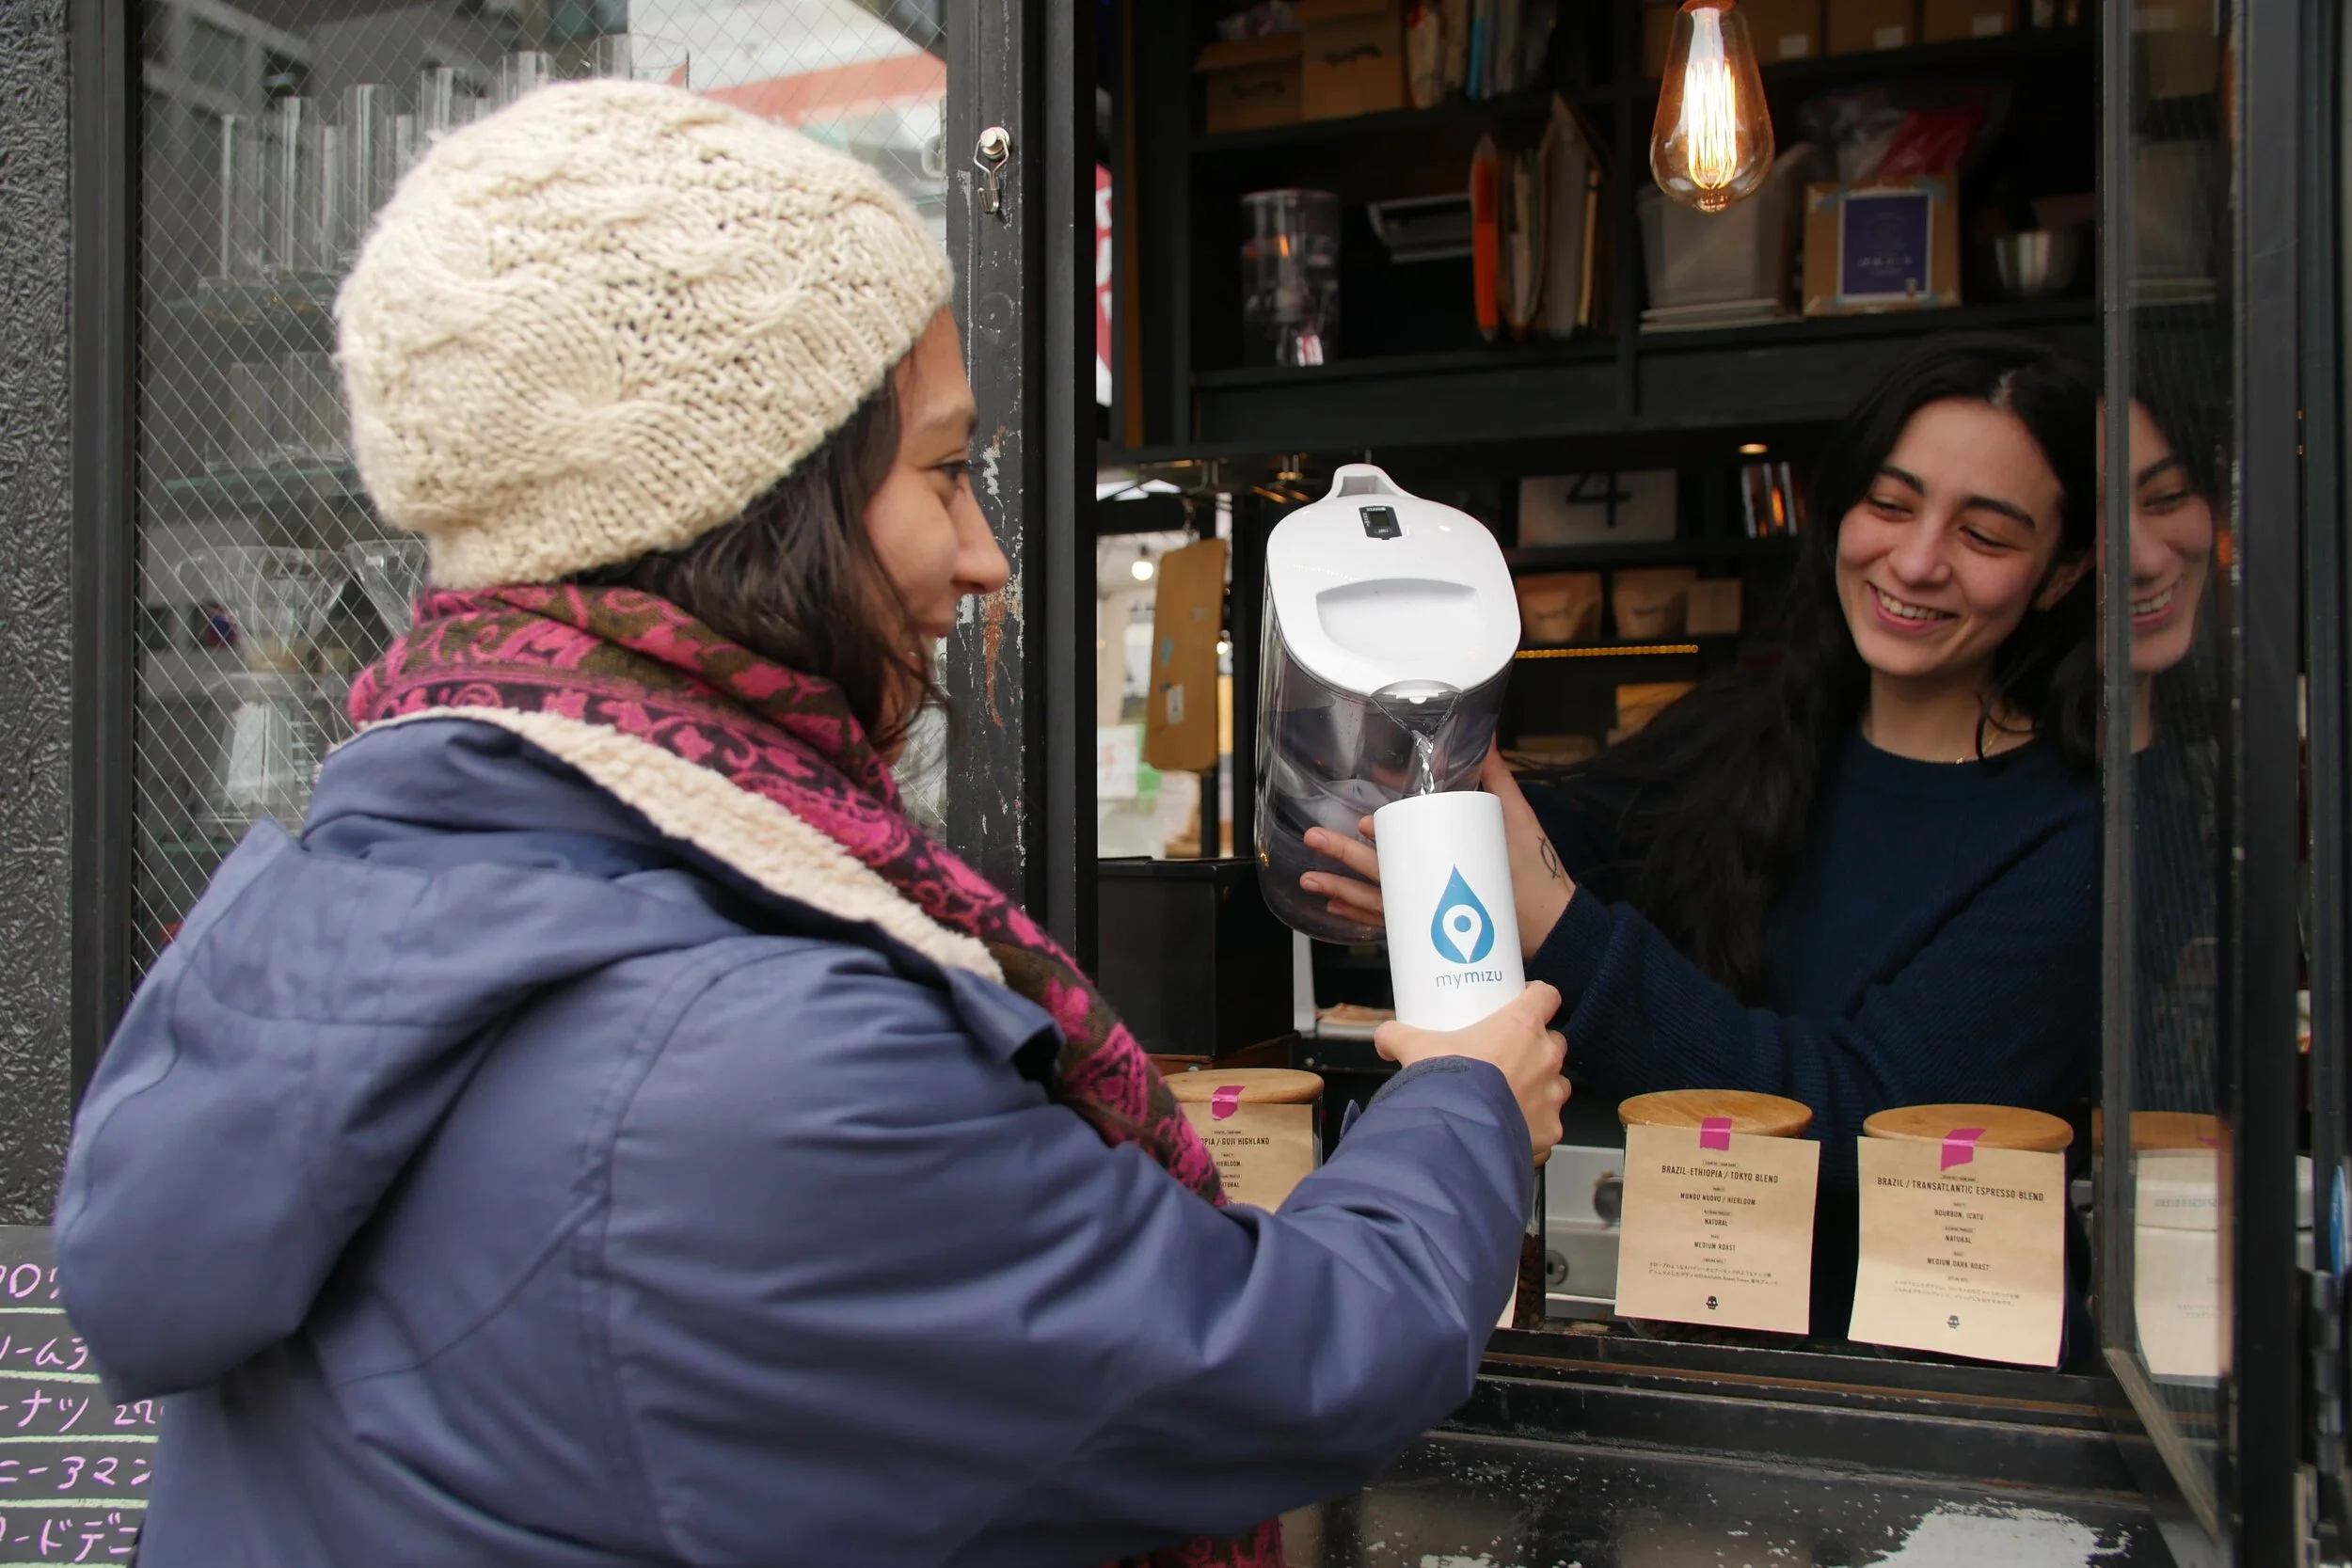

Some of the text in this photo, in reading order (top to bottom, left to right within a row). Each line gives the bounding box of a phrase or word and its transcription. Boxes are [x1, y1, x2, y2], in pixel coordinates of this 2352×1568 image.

[1436, 970, 1502, 990] mymizu
[1221, 1137, 1236, 1146] GUJI
[1661, 1164, 1723, 1179] BRAZIL-ETHIOPIA
[1730, 1171, 1753, 1182] TOKYO
[1755, 1173, 1778, 1184] BLEND
[1877, 1177, 1904, 1188] BRAZIL
[1912, 1180, 1973, 1195] TRANSATLANTIC
[1976, 1186, 2016, 1199] ESPRESSO
[2018, 1191, 2044, 1202] BLEND
[1704, 1218, 1728, 1227] NATURAL
[1945, 1235, 1972, 1244] NATURAL
[1693, 1241, 1736, 1252] MEDIUM ROAST
[1927, 1258, 1991, 1271] MEDIUM DARK ROAST
[114, 1399, 165, 1425] 27
